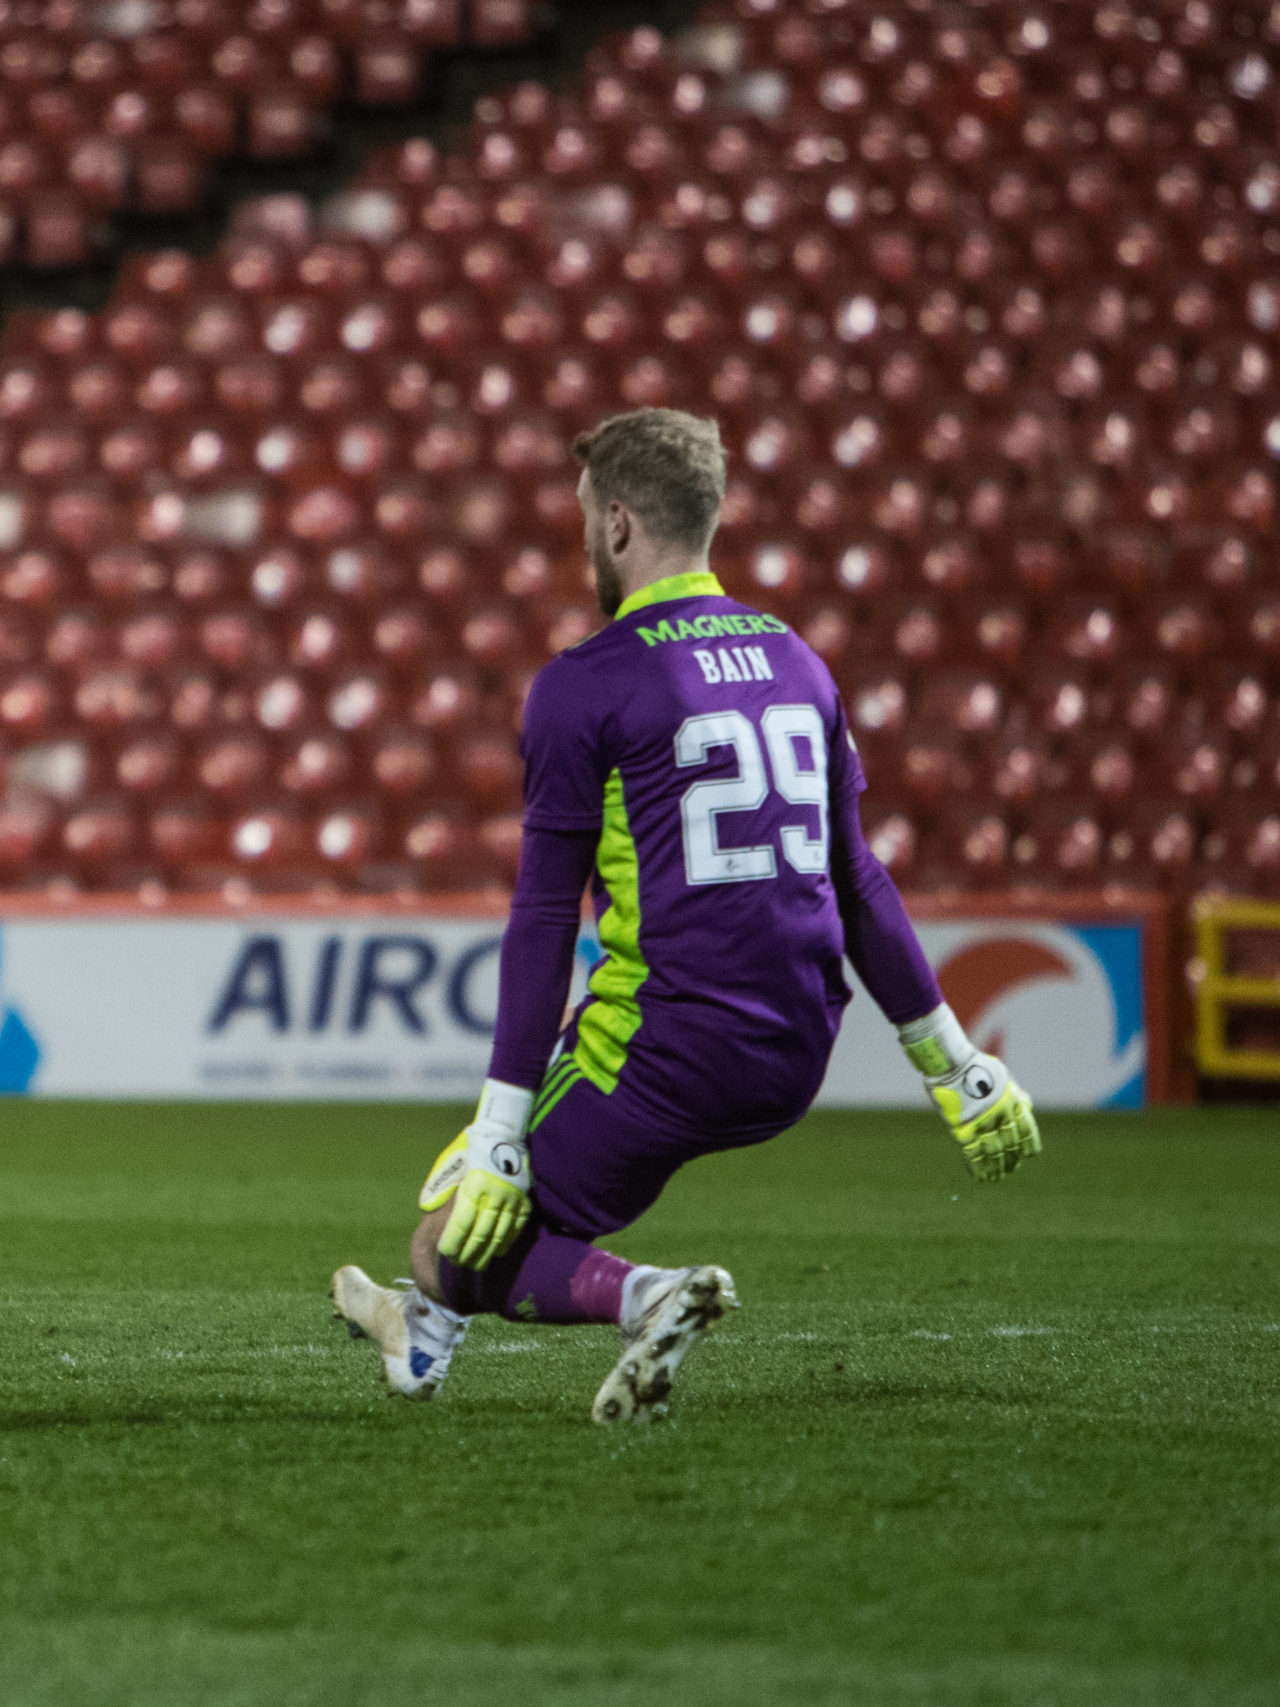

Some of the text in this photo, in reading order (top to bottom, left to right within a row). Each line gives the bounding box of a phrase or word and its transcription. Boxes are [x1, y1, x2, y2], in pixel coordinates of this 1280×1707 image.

[635, 613, 789, 647] MAGNERS
[693, 646, 774, 684] BAIN
[674, 703, 829, 886] 29
